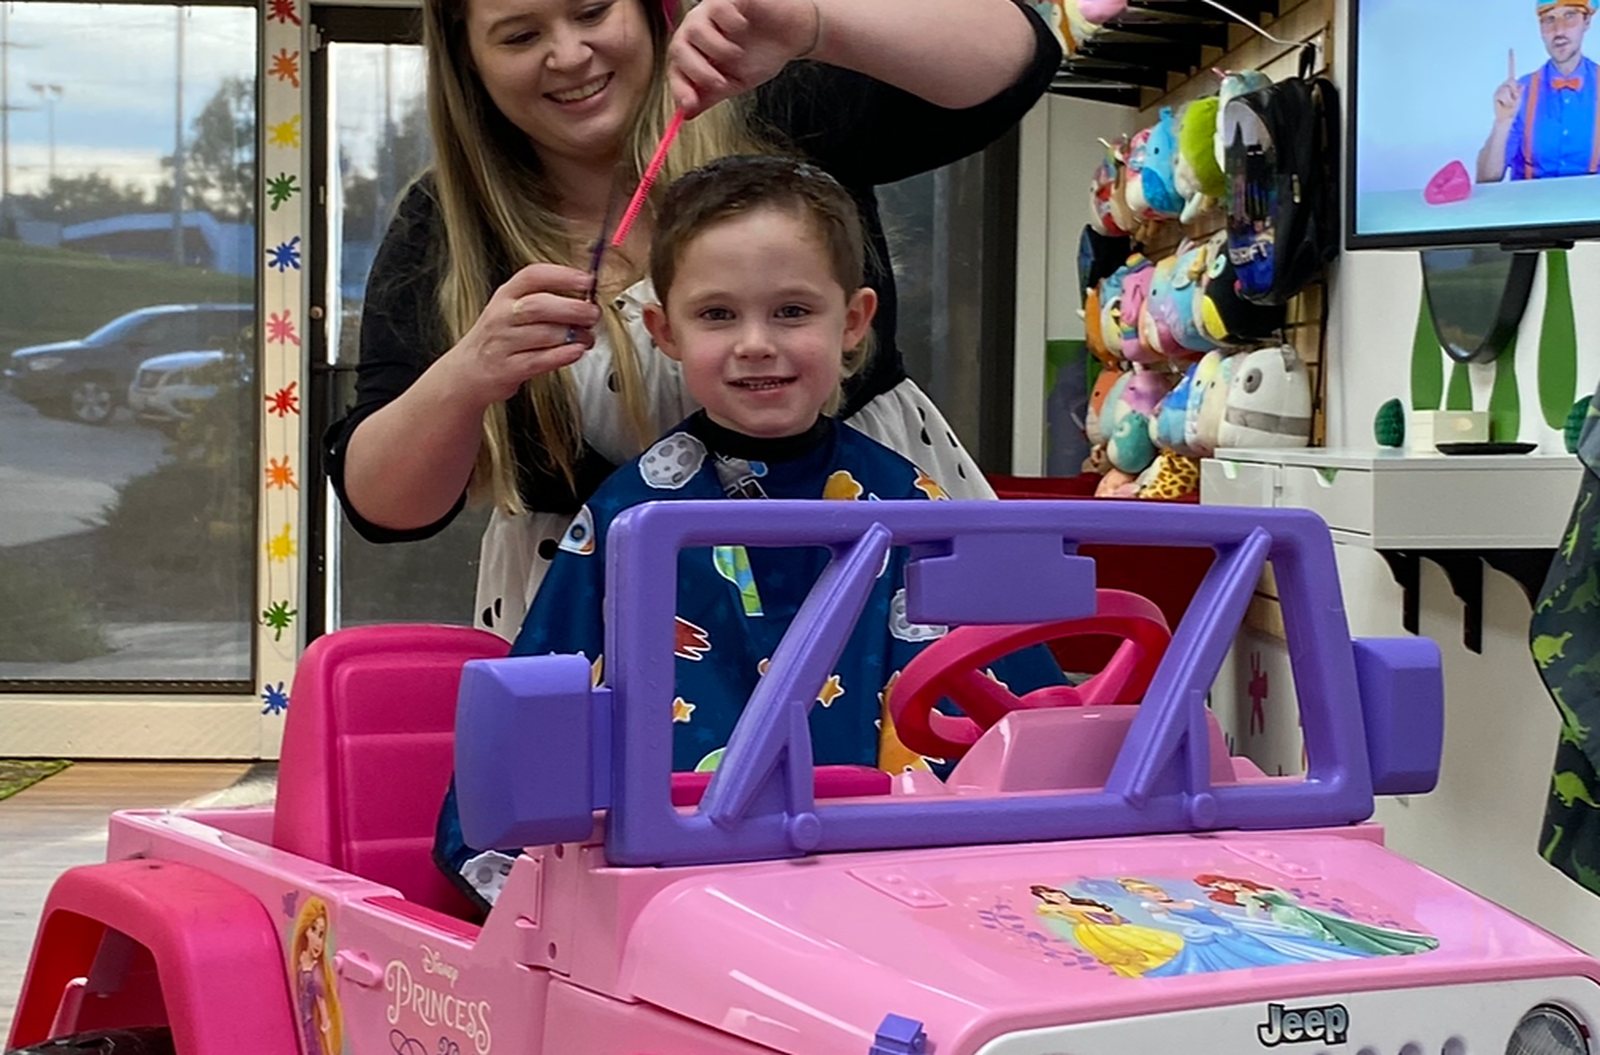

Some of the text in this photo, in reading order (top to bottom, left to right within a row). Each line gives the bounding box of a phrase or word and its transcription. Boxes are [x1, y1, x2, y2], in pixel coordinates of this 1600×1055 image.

[420, 944, 459, 988] Disney
[384, 960, 492, 1055] PRINCESS
[1258, 1003, 1349, 1046] Jeep
